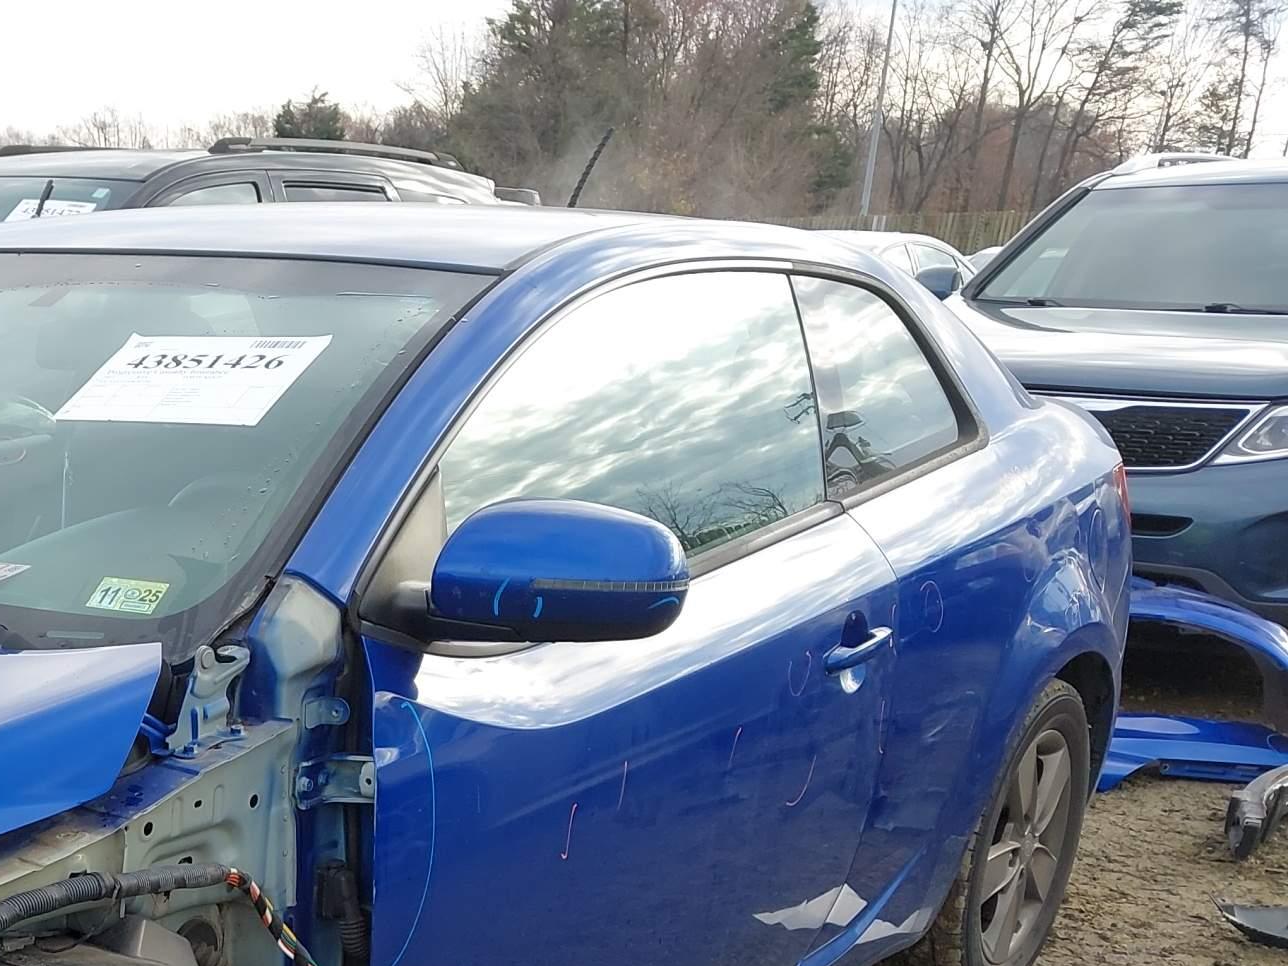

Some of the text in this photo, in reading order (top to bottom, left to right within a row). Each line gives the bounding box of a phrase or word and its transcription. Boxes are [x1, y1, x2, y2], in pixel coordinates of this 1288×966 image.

[126, 354, 289, 370] 43851426
[98, 586, 162, 605] 11 25
